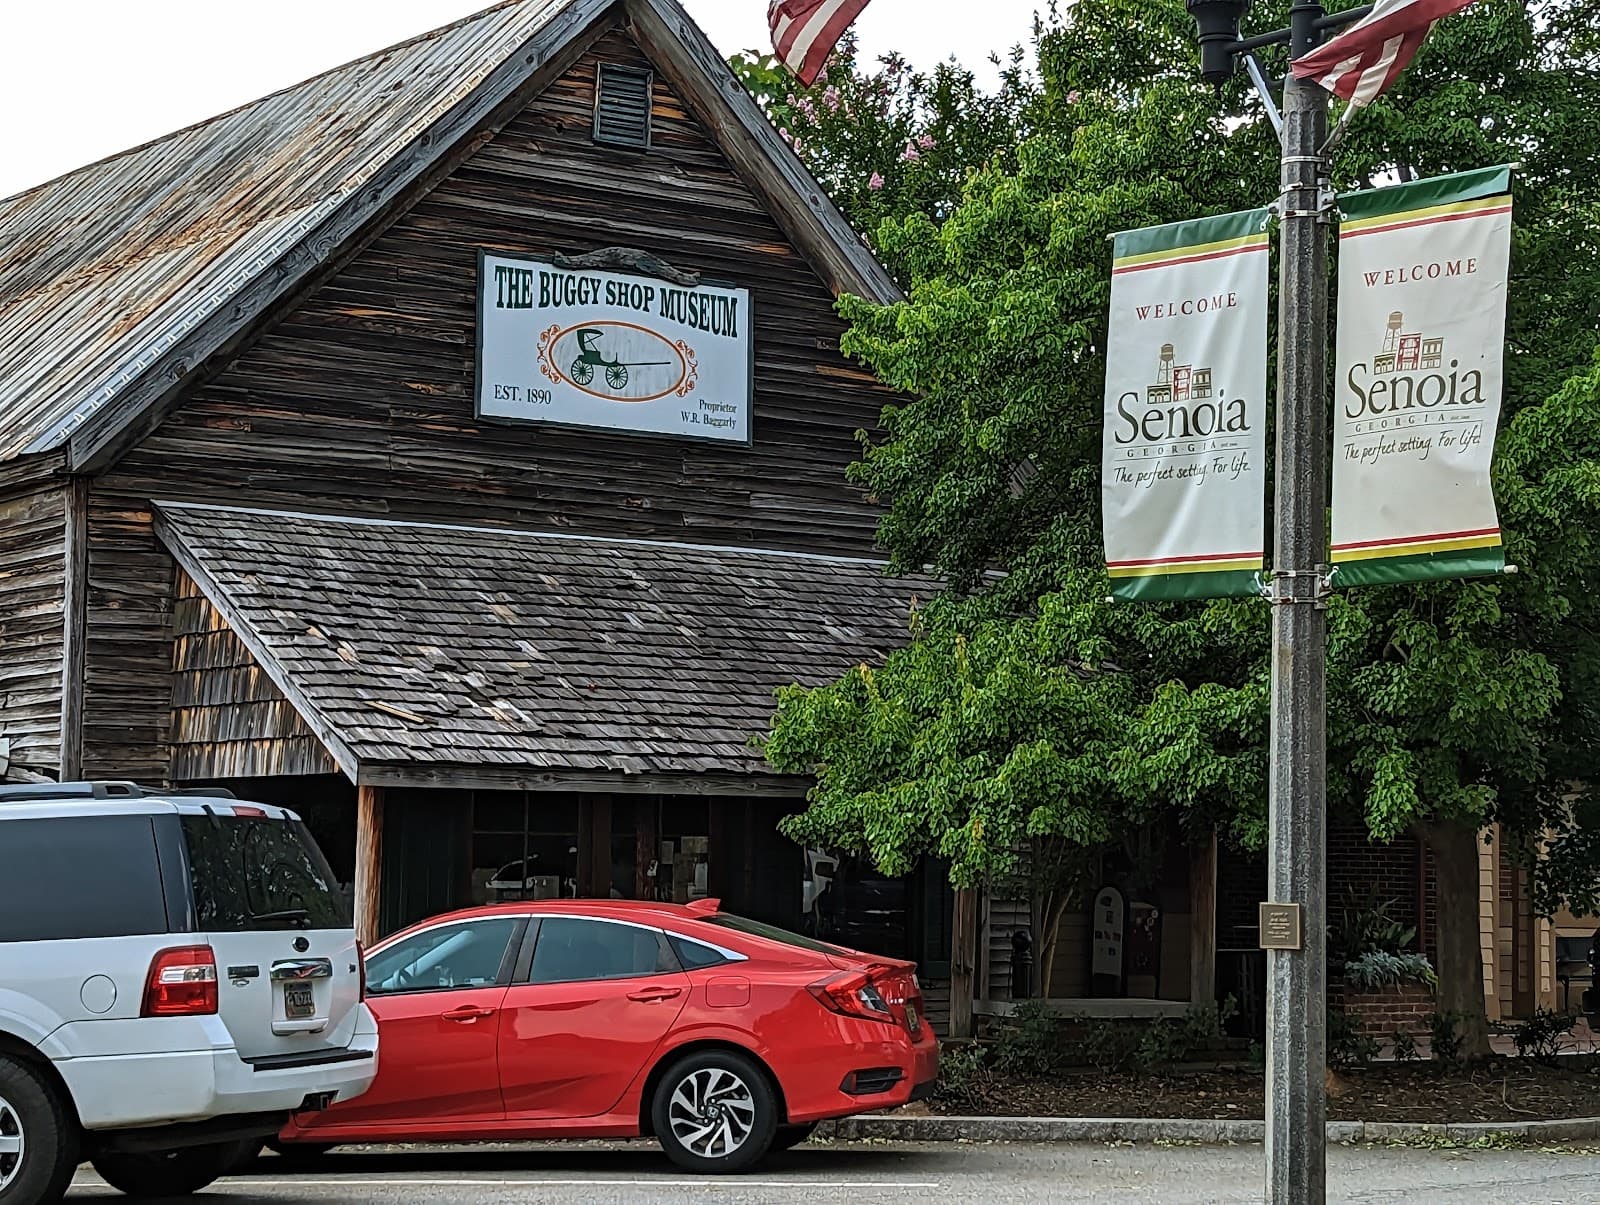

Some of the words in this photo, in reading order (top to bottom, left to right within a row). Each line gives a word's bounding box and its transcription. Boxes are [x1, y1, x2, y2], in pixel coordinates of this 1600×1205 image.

[1363, 257, 1478, 288] WELCOME
[494, 265, 533, 310] THE
[539, 271, 601, 308] BUGGY
[605, 279, 655, 313] SHOP
[660, 287, 738, 338] MUSEUM
[1136, 292, 1238, 322] WELCOME
[494, 384, 522, 402] EST.
[527, 388, 552, 405] 1890
[1345, 359, 1486, 420] Senoia
[699, 399, 737, 414] Proprietor
[1114, 388, 1251, 445] Senoia
[1344, 442, 1360, 462] The
[1360, 434, 1396, 465] perfect
[1438, 430, 1457, 447] For
[1114, 467, 1134, 484] The
[1135, 460, 1175, 489] perfect
[1213, 456, 1231, 473] For
